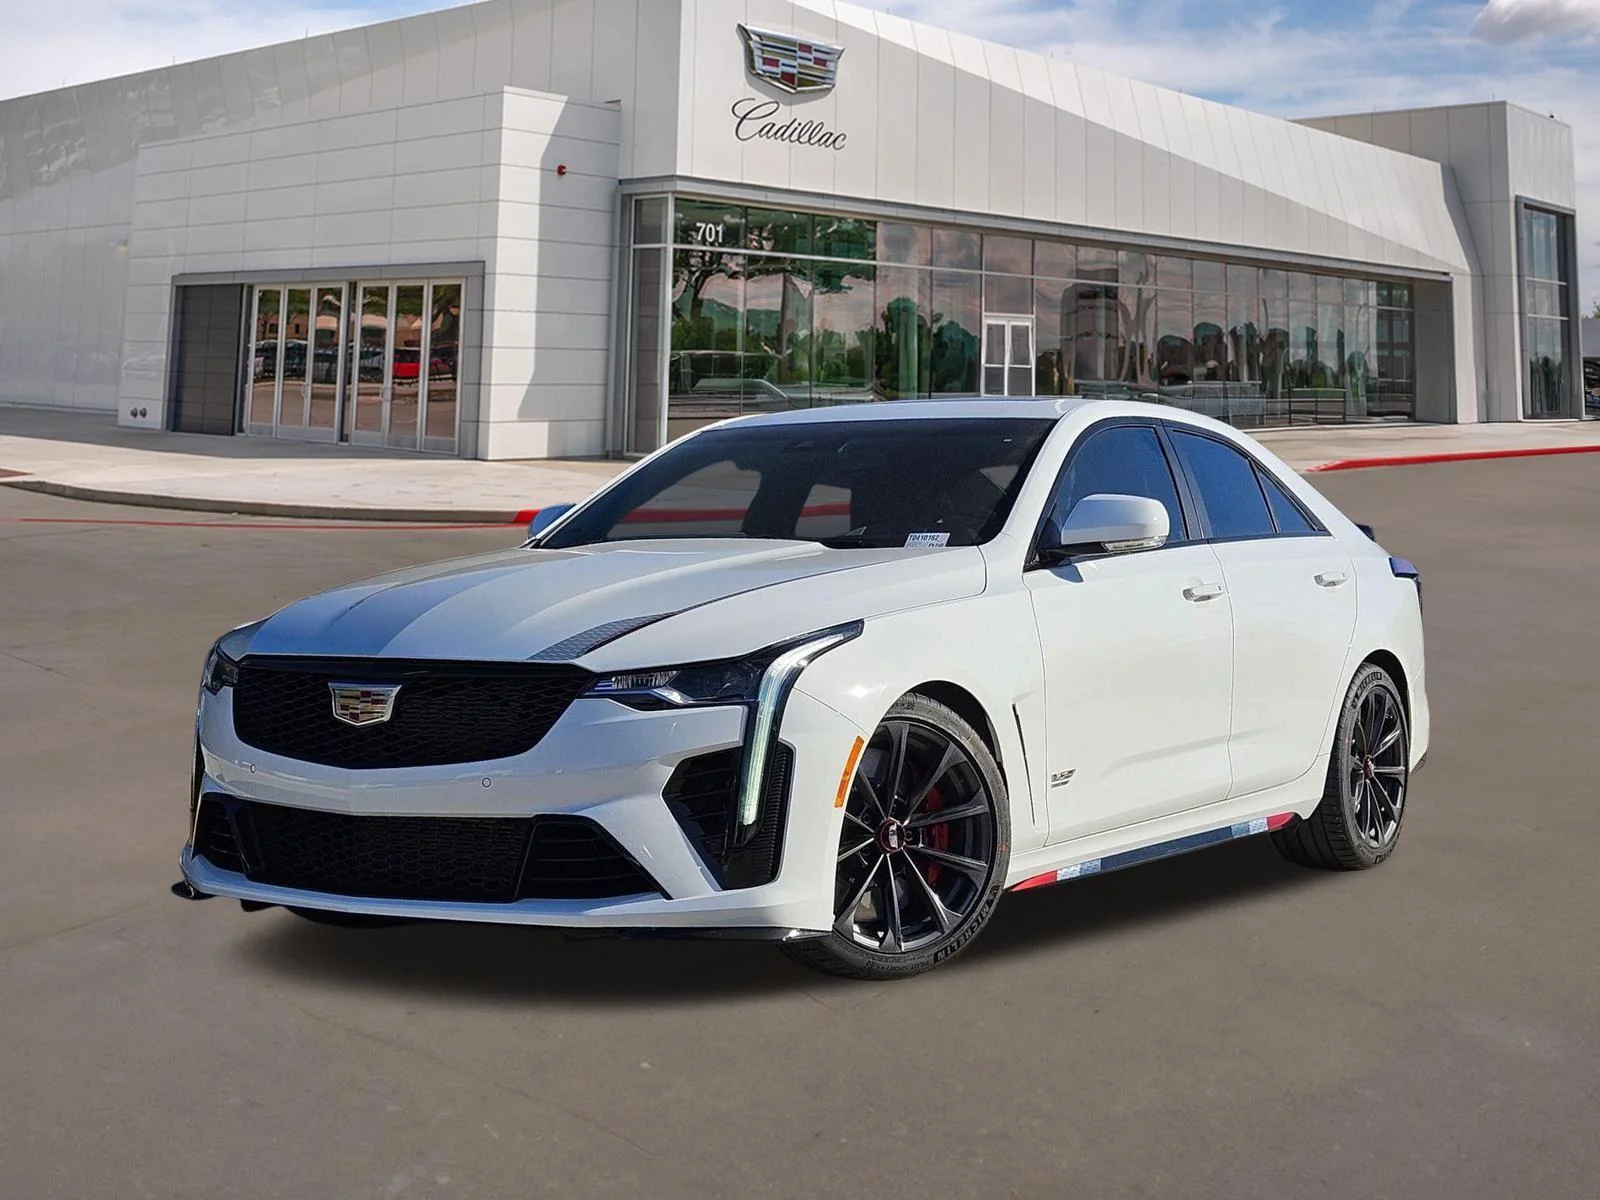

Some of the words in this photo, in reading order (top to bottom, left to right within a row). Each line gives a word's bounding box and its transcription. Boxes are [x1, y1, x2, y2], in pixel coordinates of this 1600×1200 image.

[731, 97, 847, 151] Cadillac
[695, 222, 724, 243] 701
[936, 904, 990, 961] MICHELIN
